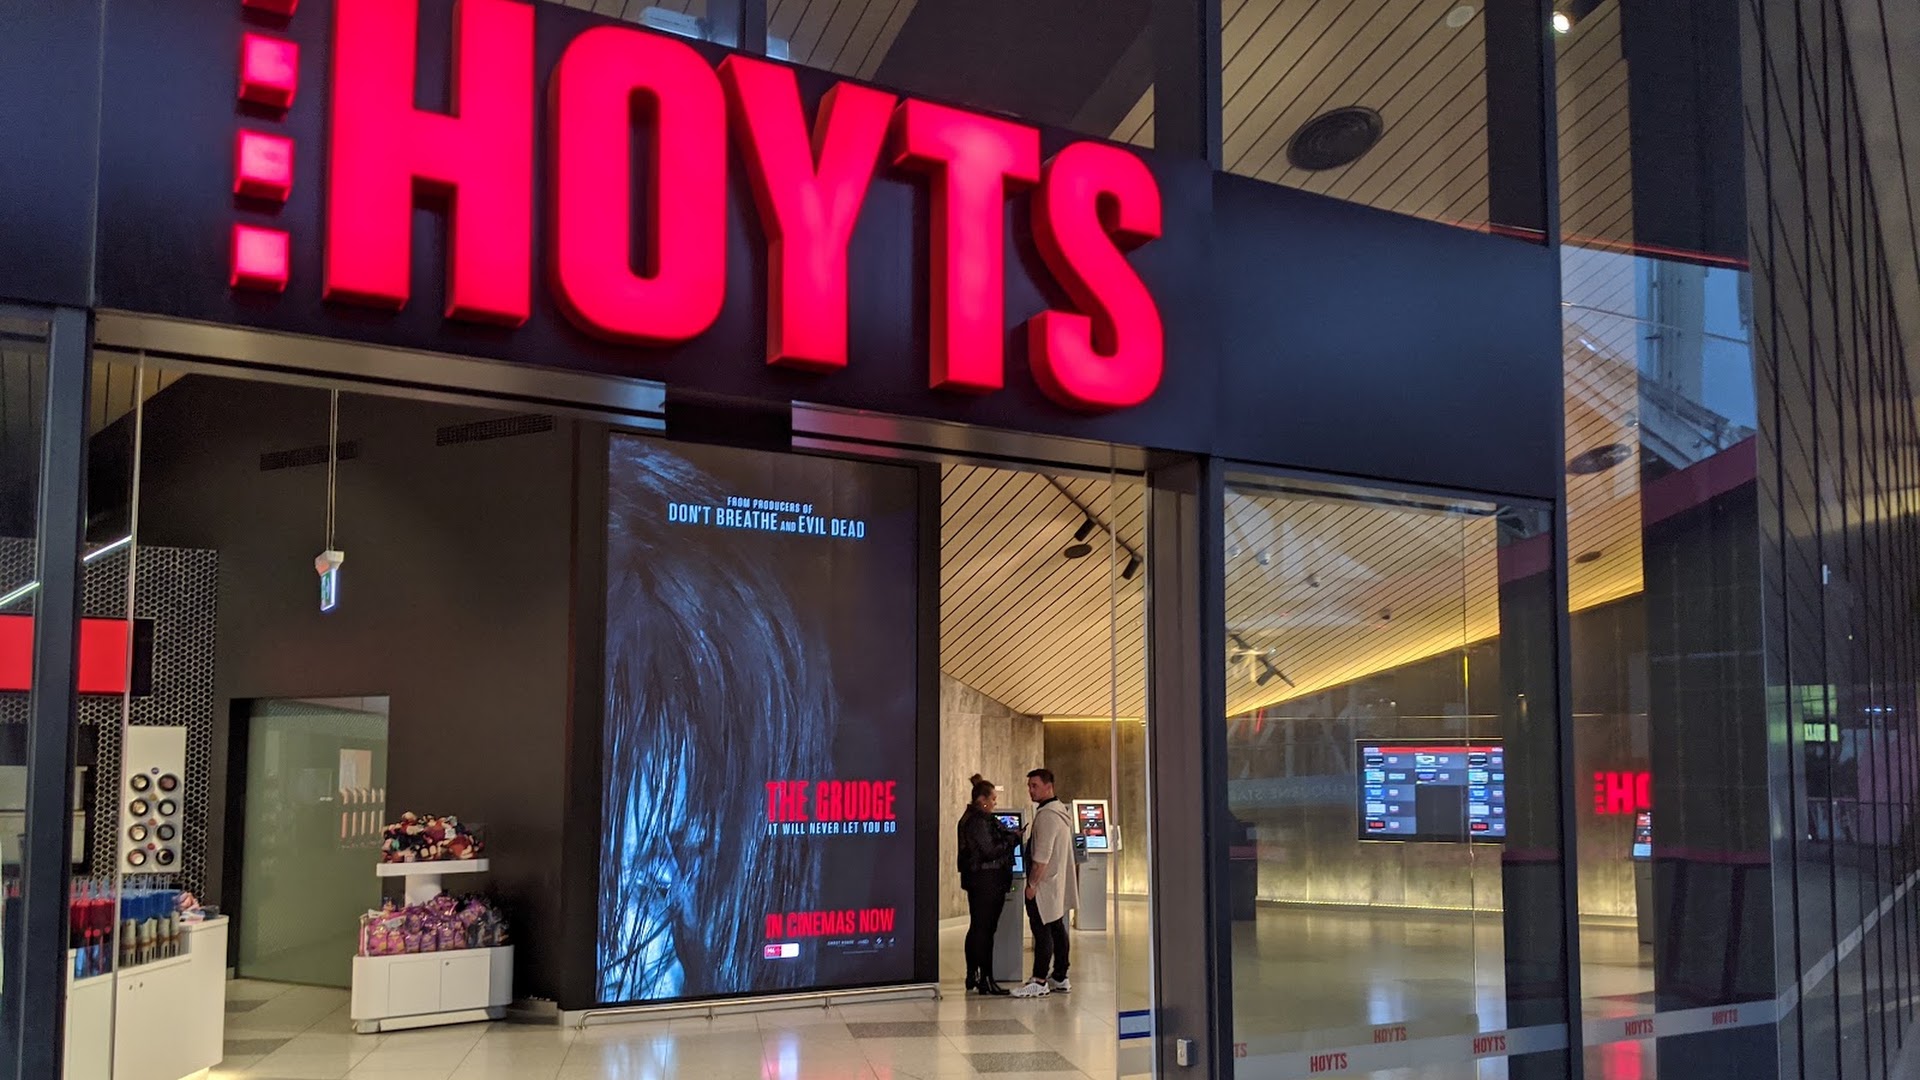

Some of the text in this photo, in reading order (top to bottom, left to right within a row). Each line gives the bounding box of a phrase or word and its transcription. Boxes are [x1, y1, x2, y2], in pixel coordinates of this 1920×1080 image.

[323, 0, 1164, 414] HOYTS
[727, 496, 813, 515] FROM PRODUCERS OF
[668, 502, 865, 539] DON'T BREATHE AND EVIL DEAD
[765, 780, 896, 822] THE GRUDGE
[768, 821, 896, 836] IT WILL NEVER LET YOU GO
[765, 907, 896, 939] IN CINEMAS NOW
[1712, 1009, 1738, 1025] HOYTS
[1374, 1026, 1407, 1044] HOYTS
[1625, 1019, 1654, 1036] HOYTS
[1473, 1035, 1506, 1054] HOYTS
[1310, 1052, 1348, 1073] HOYTS
